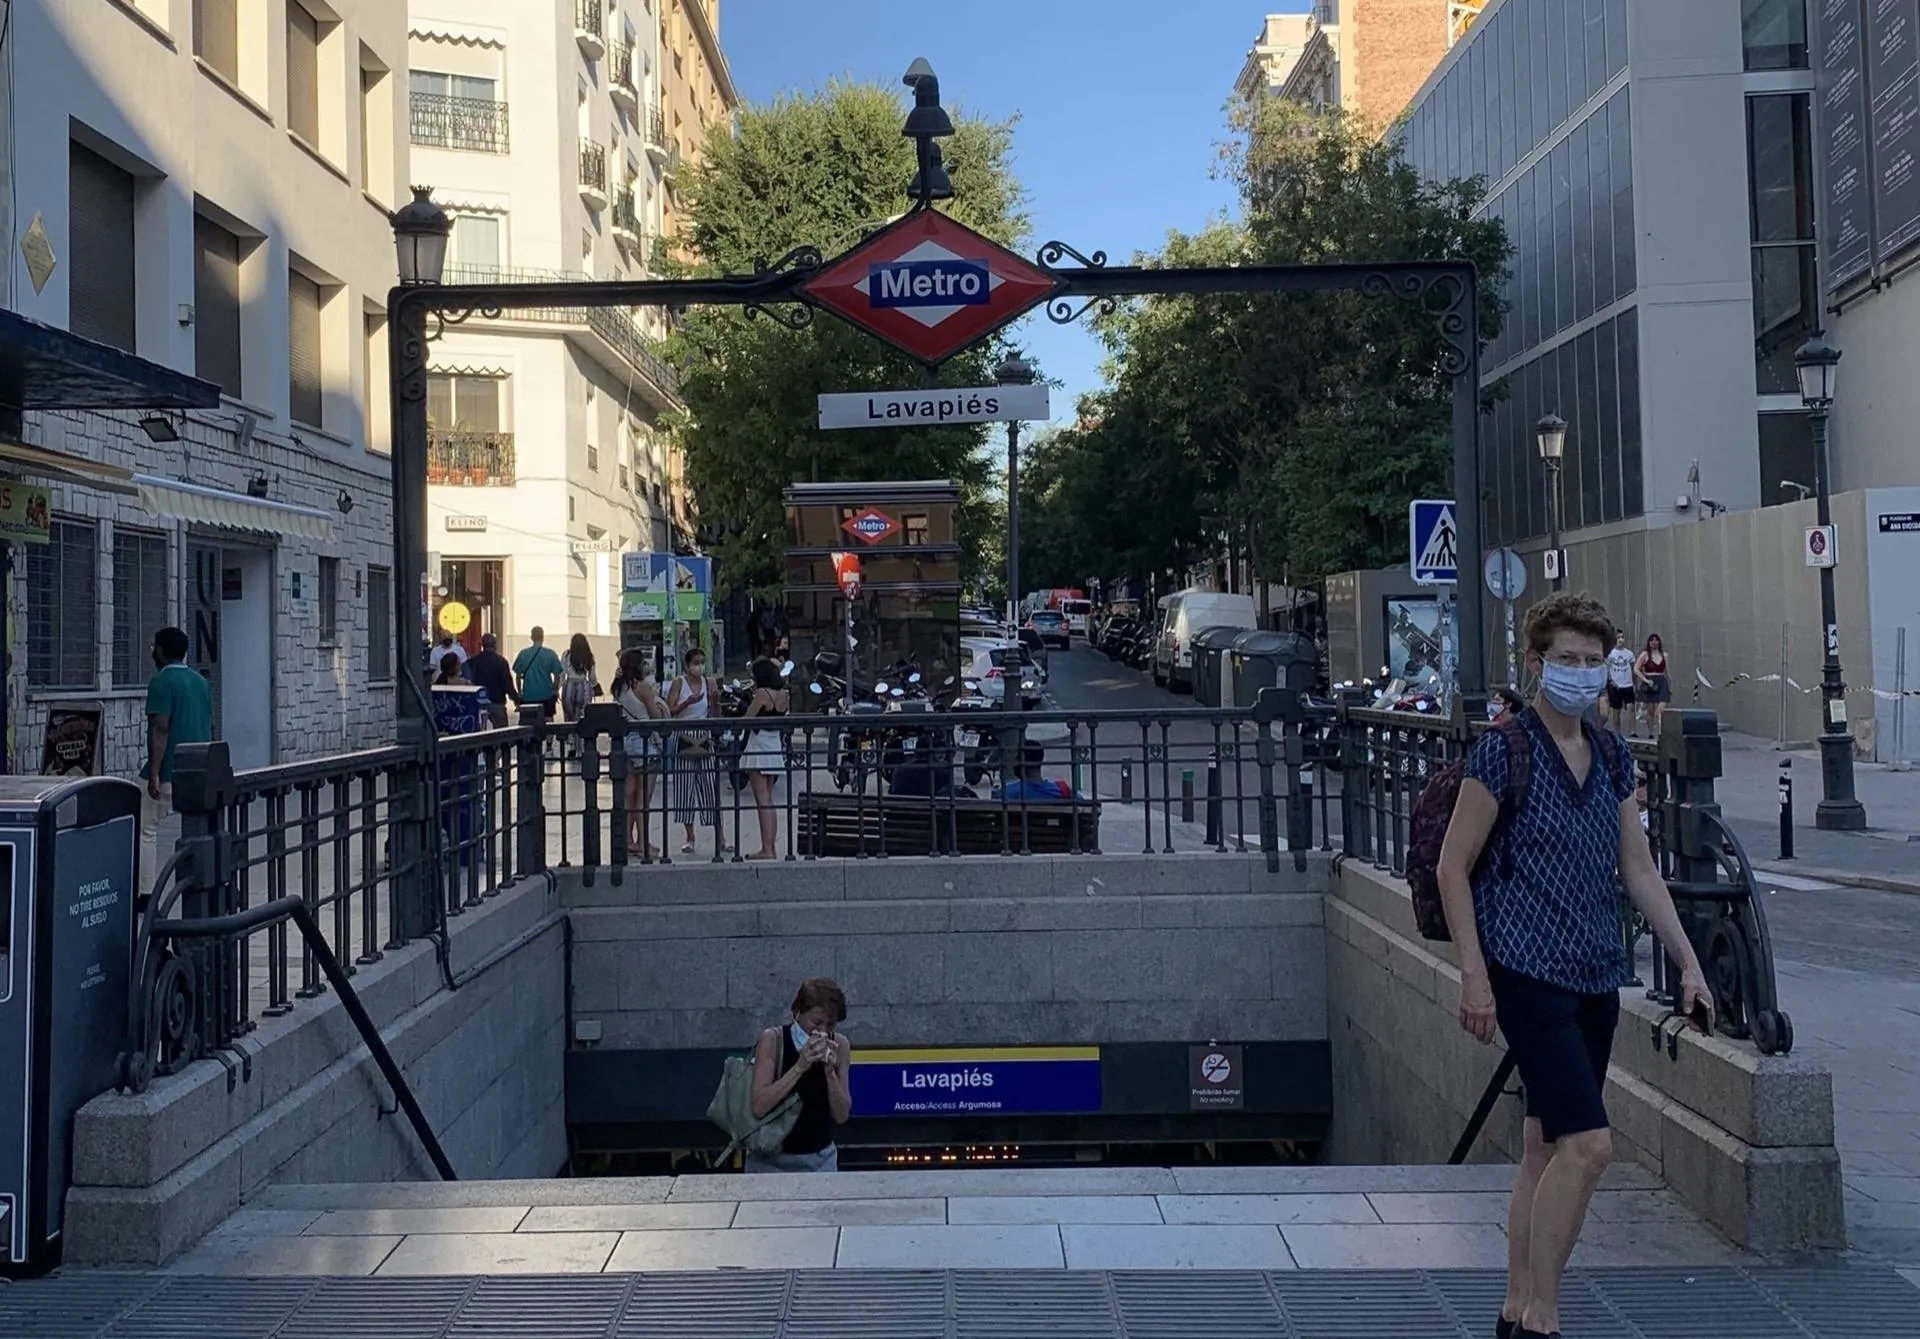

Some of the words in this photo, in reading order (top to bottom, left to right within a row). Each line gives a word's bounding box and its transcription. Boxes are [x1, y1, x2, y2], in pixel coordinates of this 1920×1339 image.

[880, 268, 981, 299] Metro
[867, 393, 1000, 421] Lavapiés
[857, 521, 886, 531] Metro
[79, 883, 91, 898] POR
[69, 904, 79, 916] NO
[80, 899, 92, 913] TIRE
[92, 891, 118, 909] RESIDUOS
[81, 916, 90, 929] AL
[90, 910, 107, 926] SUELO
[901, 1068, 994, 1092] Lavapiés
[1192, 1088, 1222, 1096] Prohibido
[958, 1100, 1002, 1111] Argumosa
